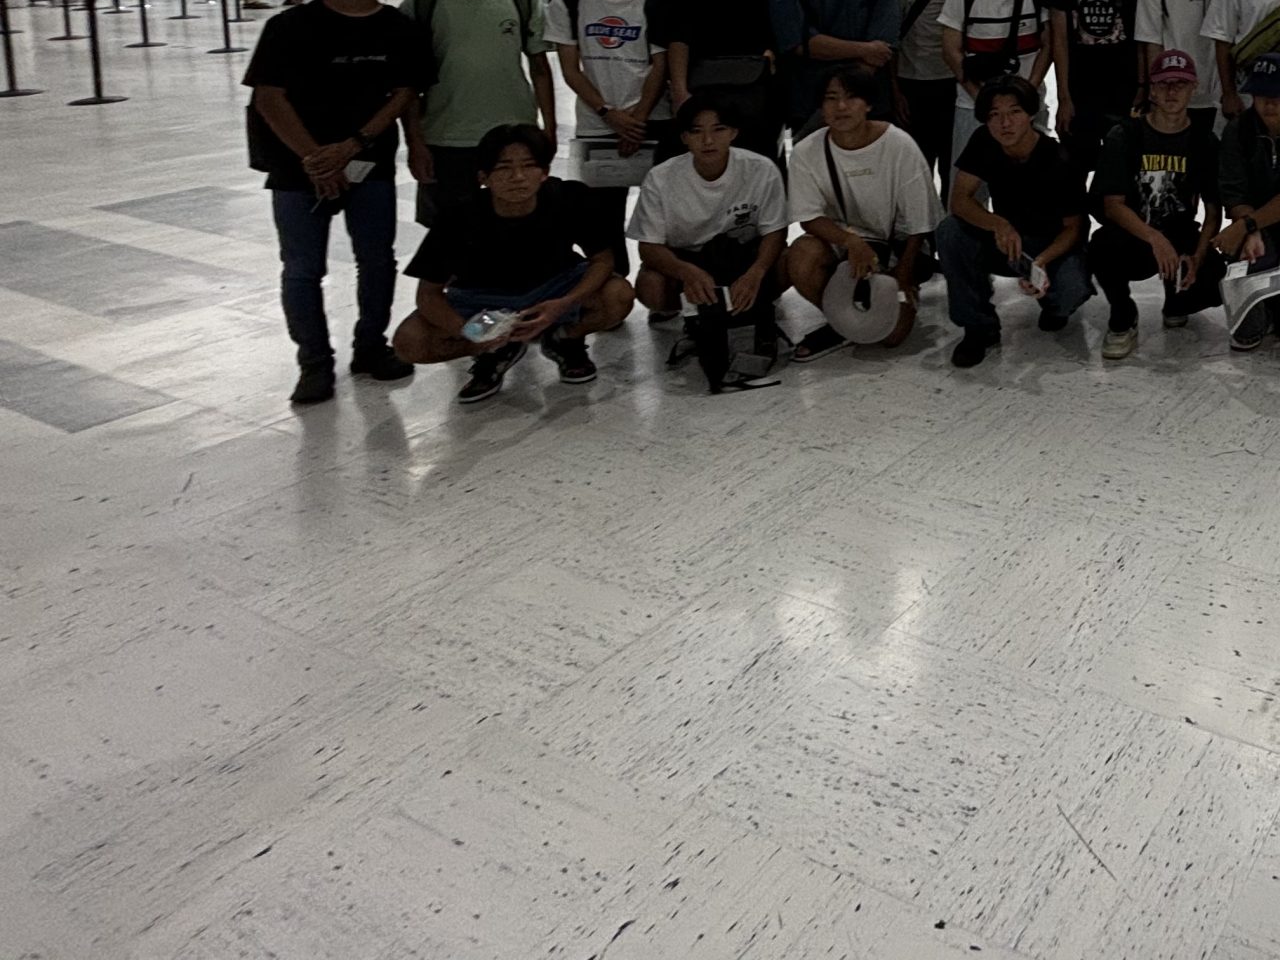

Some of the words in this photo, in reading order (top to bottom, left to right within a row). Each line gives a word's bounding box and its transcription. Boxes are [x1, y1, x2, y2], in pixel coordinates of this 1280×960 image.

[613, 27, 637, 38] SEAL
[1253, 60, 1277, 75] GAP
[1140, 154, 1187, 173] NIRVANA
